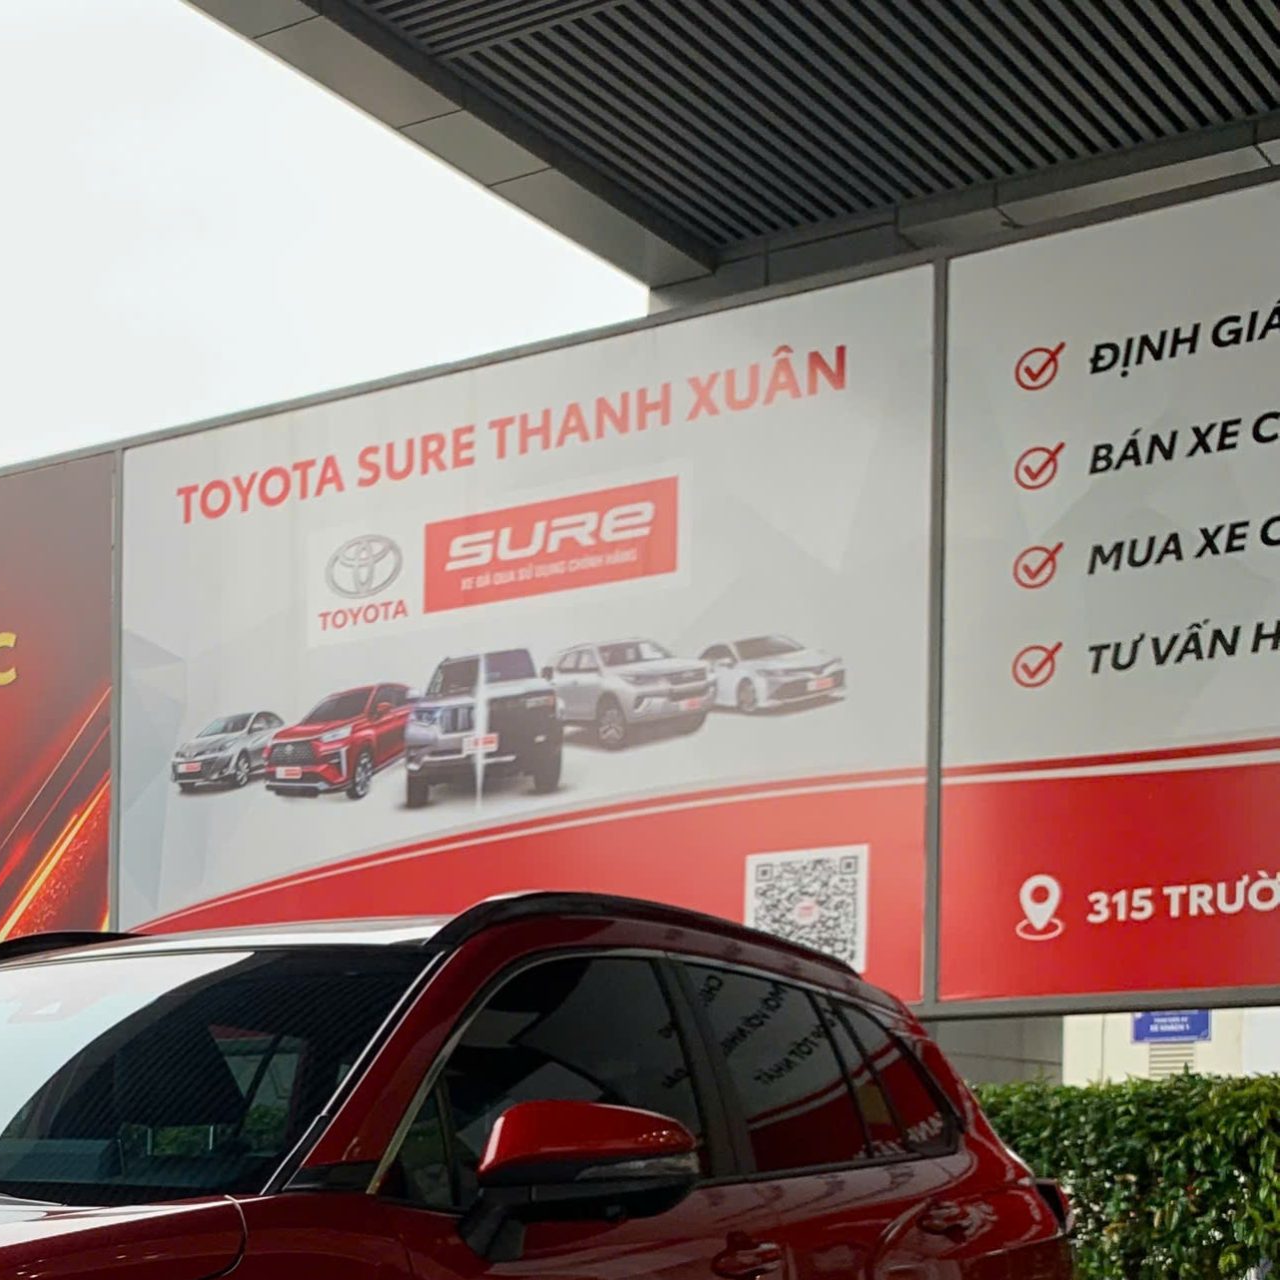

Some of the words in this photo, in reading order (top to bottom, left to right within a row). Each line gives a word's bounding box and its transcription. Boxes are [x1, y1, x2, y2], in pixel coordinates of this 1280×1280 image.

[1089, 322, 1201, 378] ĐỊNH
[177, 454, 345, 525] TOYOTA
[357, 424, 476, 489] SURE
[488, 381, 672, 460] THANH
[685, 344, 847, 420] XUÂN
[1088, 428, 1179, 475] BÁN
[1185, 417, 1242, 457] XE
[445, 501, 656, 571] SURE
[1087, 532, 1184, 576] MUA
[1195, 520, 1250, 558] XE
[319, 599, 409, 632] TOYOTA
[1088, 633, 1145, 675] TƯ
[1152, 618, 1242, 666] VẤN
[1086, 887, 1155, 924] 315
[1162, 870, 1280, 919] TRƯỜ
